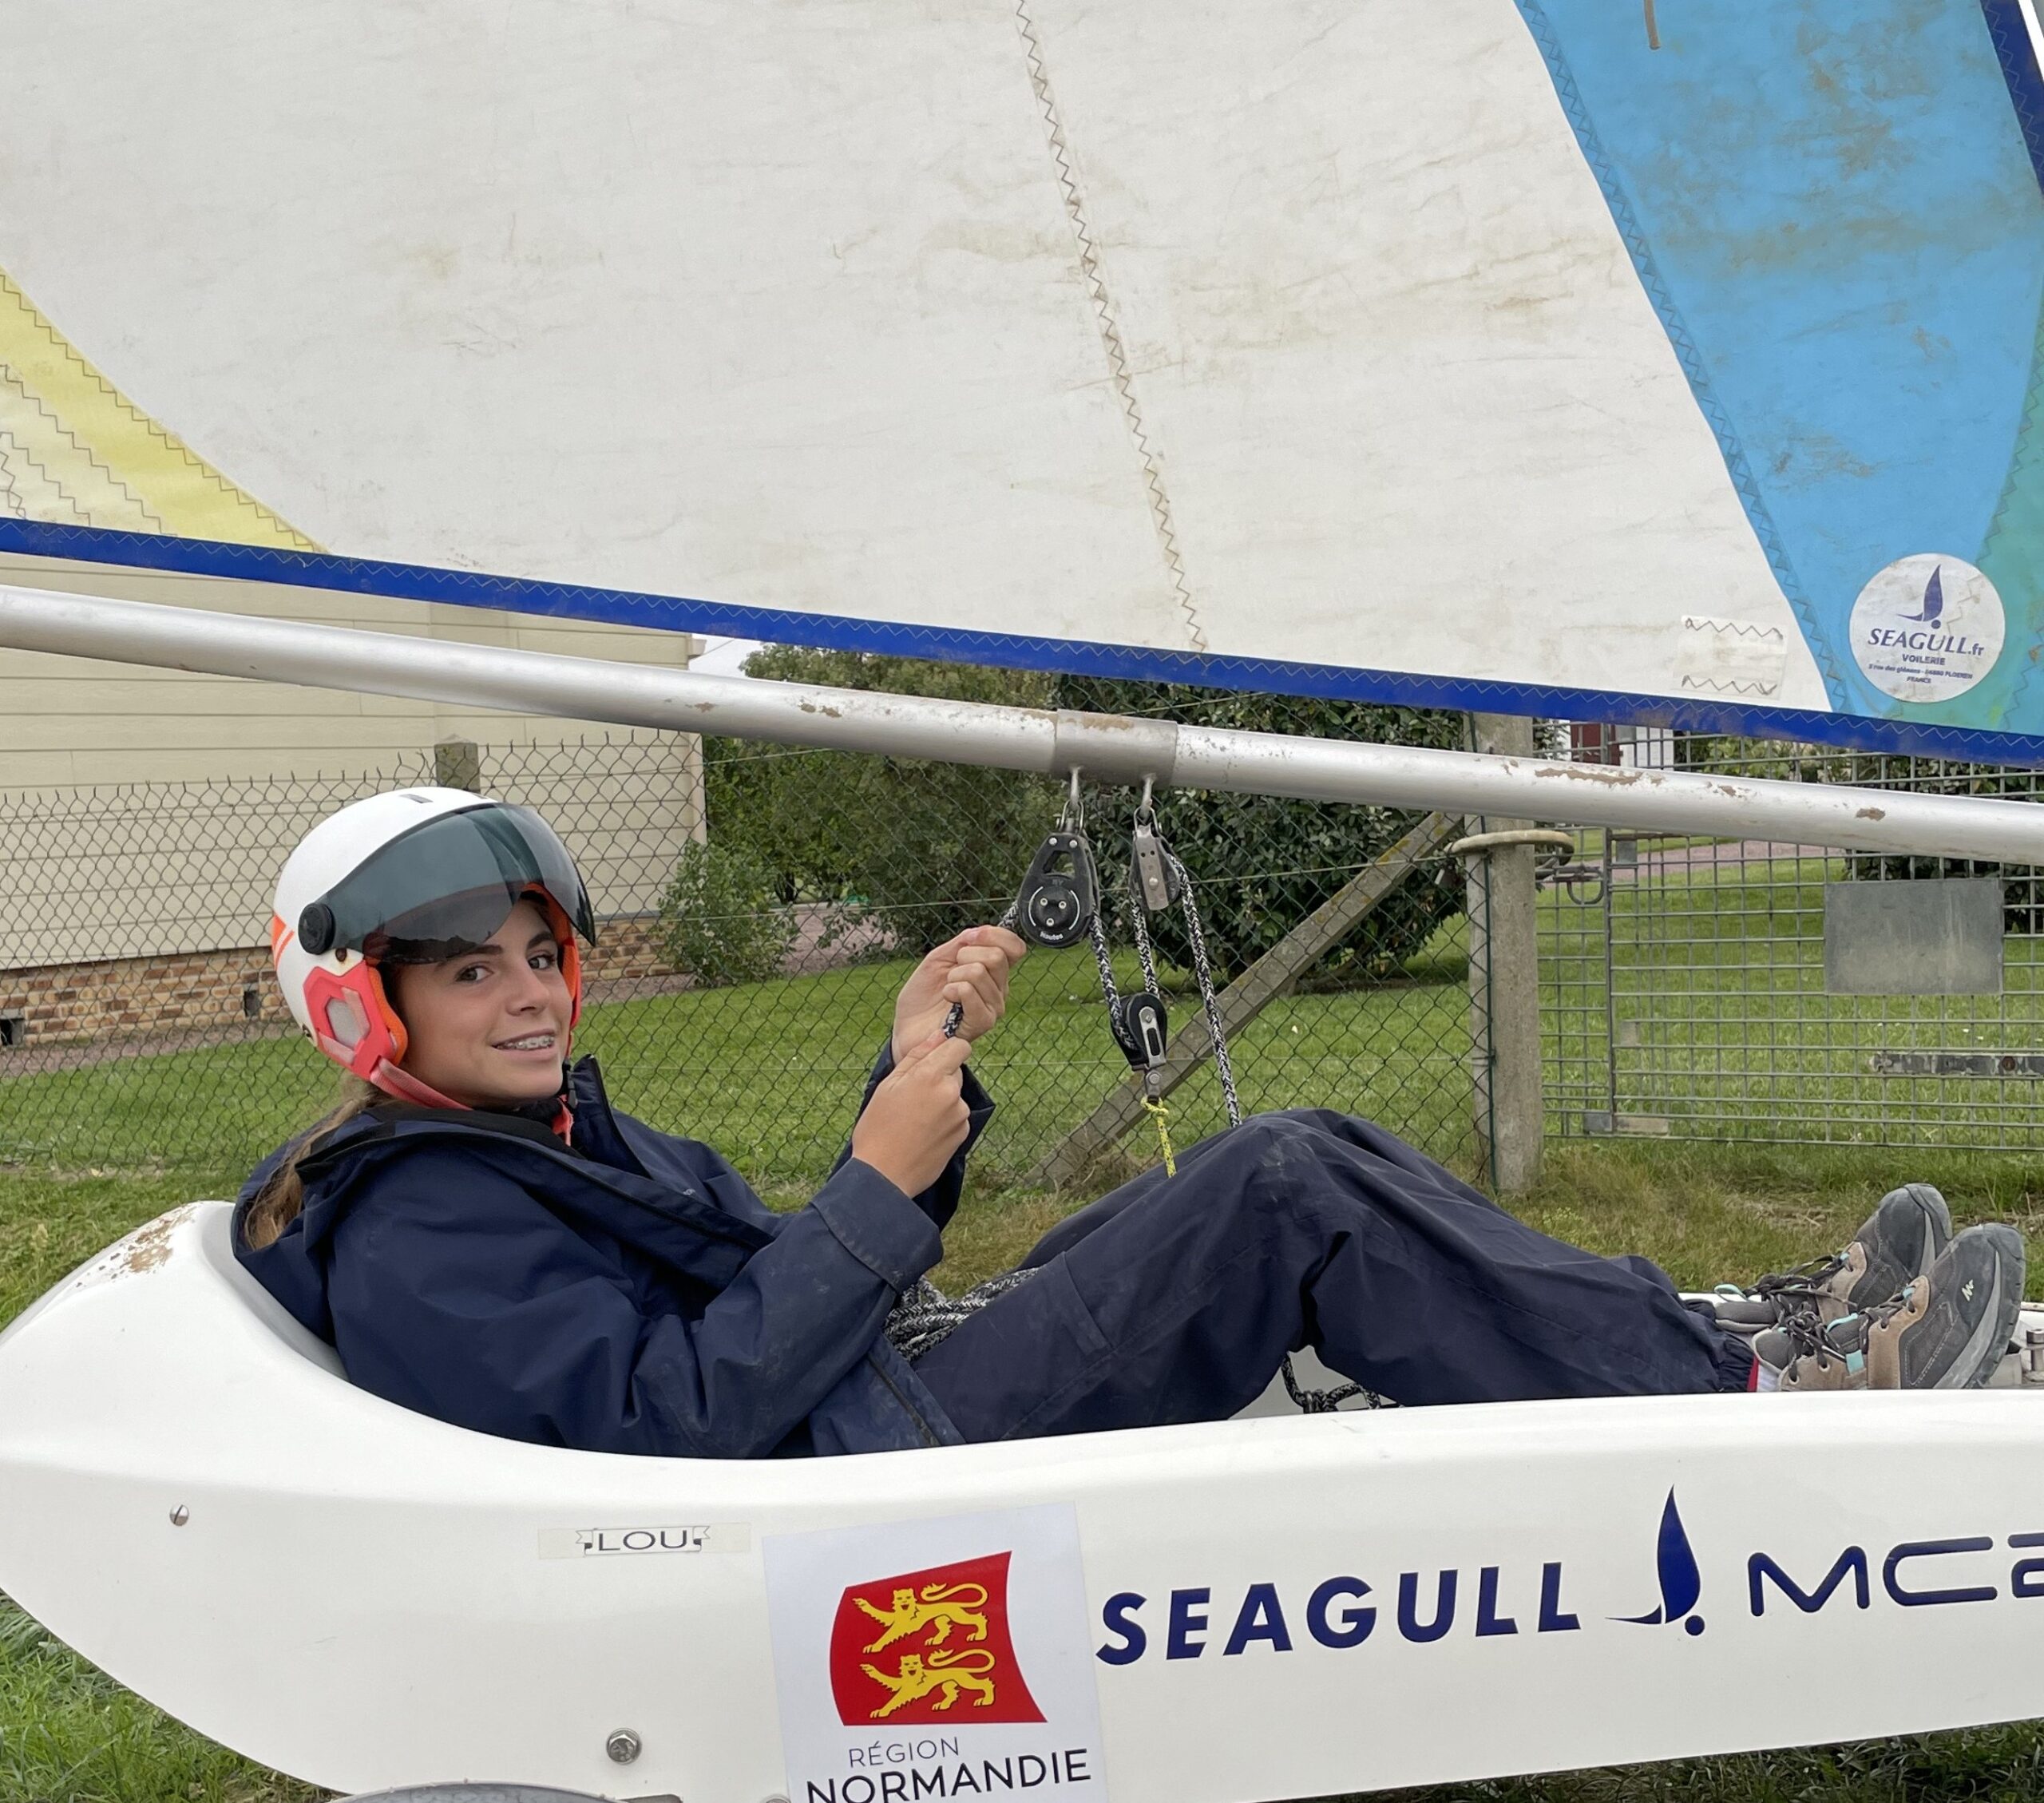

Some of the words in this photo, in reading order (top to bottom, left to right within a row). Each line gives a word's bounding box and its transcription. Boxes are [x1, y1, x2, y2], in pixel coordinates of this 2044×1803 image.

[1868, 628, 1985, 656] SEAGULL.fr
[1902, 653, 1946, 666] VOILERIE
[598, 1529, 687, 1551] LOU
[1095, 1562, 1581, 1666] SEAGULL
[848, 1736, 960, 1769] RÉGION
[806, 1748, 1091, 1803] NORMANDIE
